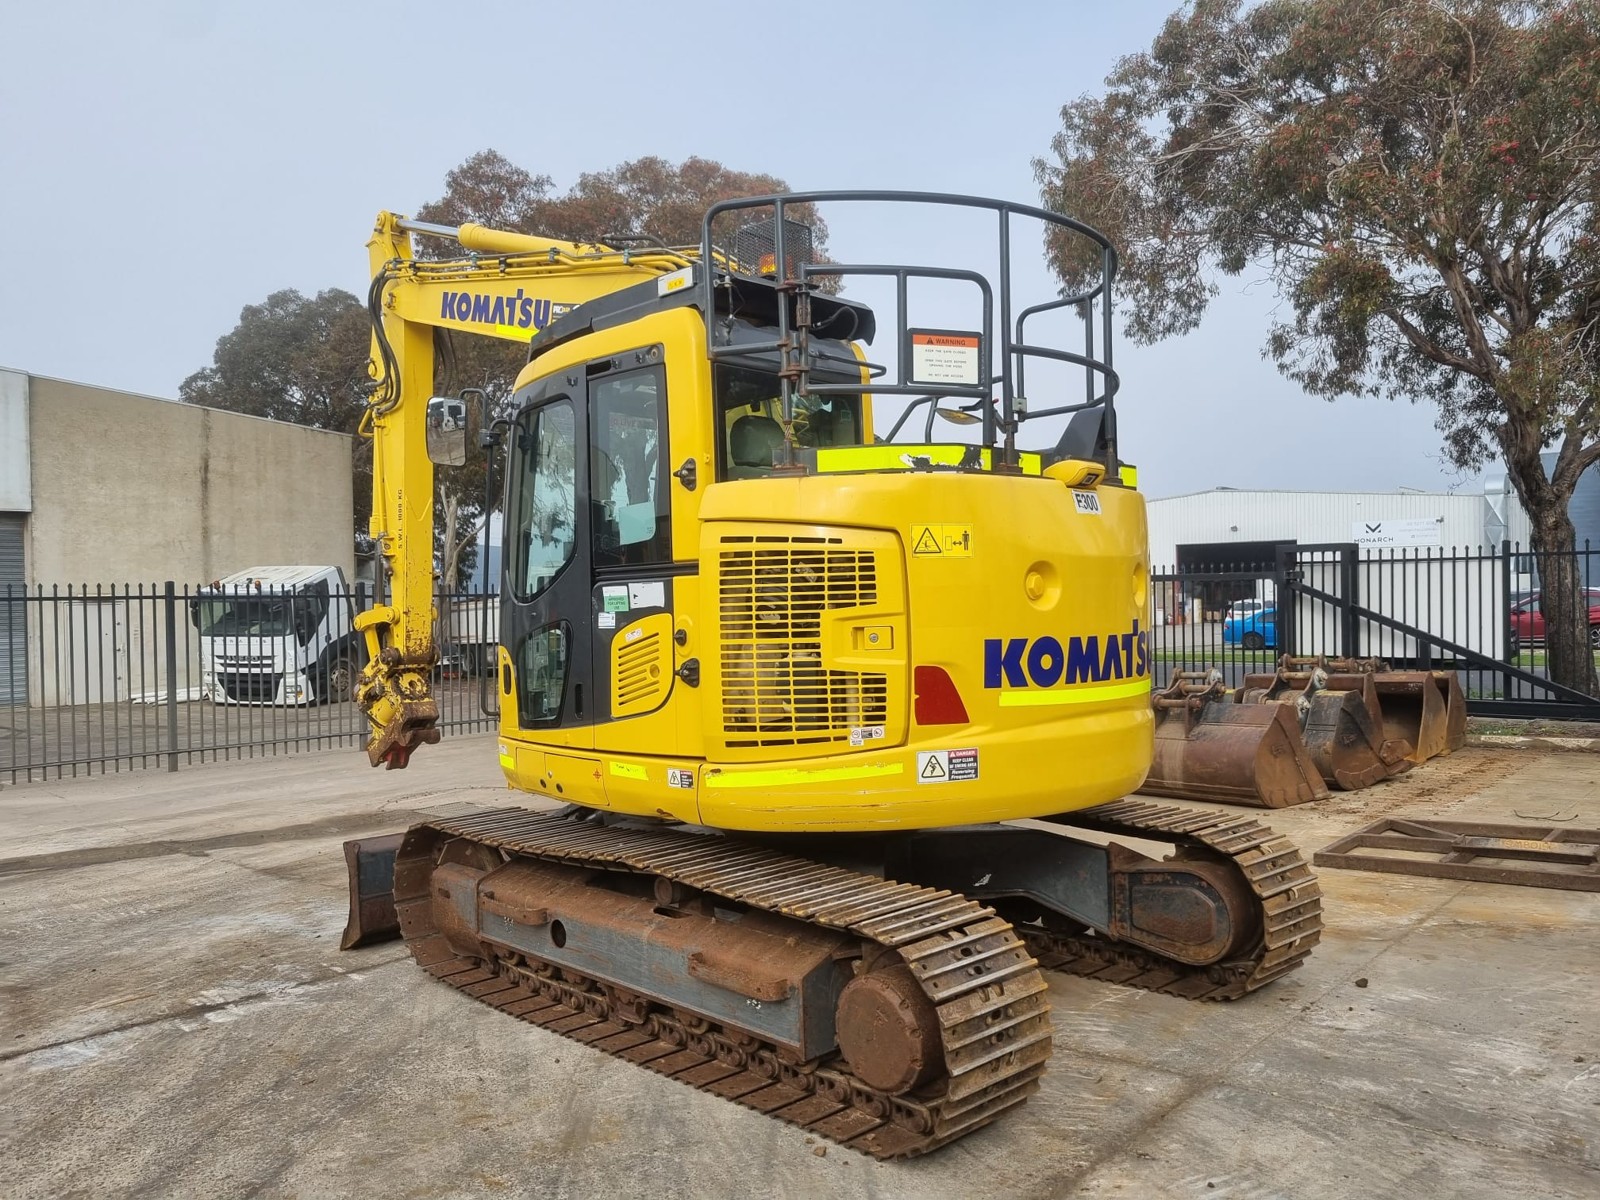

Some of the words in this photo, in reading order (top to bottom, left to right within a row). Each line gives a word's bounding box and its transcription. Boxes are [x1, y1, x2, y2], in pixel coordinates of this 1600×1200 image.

[441, 288, 551, 330] KOMATSU
[935, 338, 966, 346] WARNING
[398, 489, 403, 500] KG
[1075, 493, 1099, 511] E300
